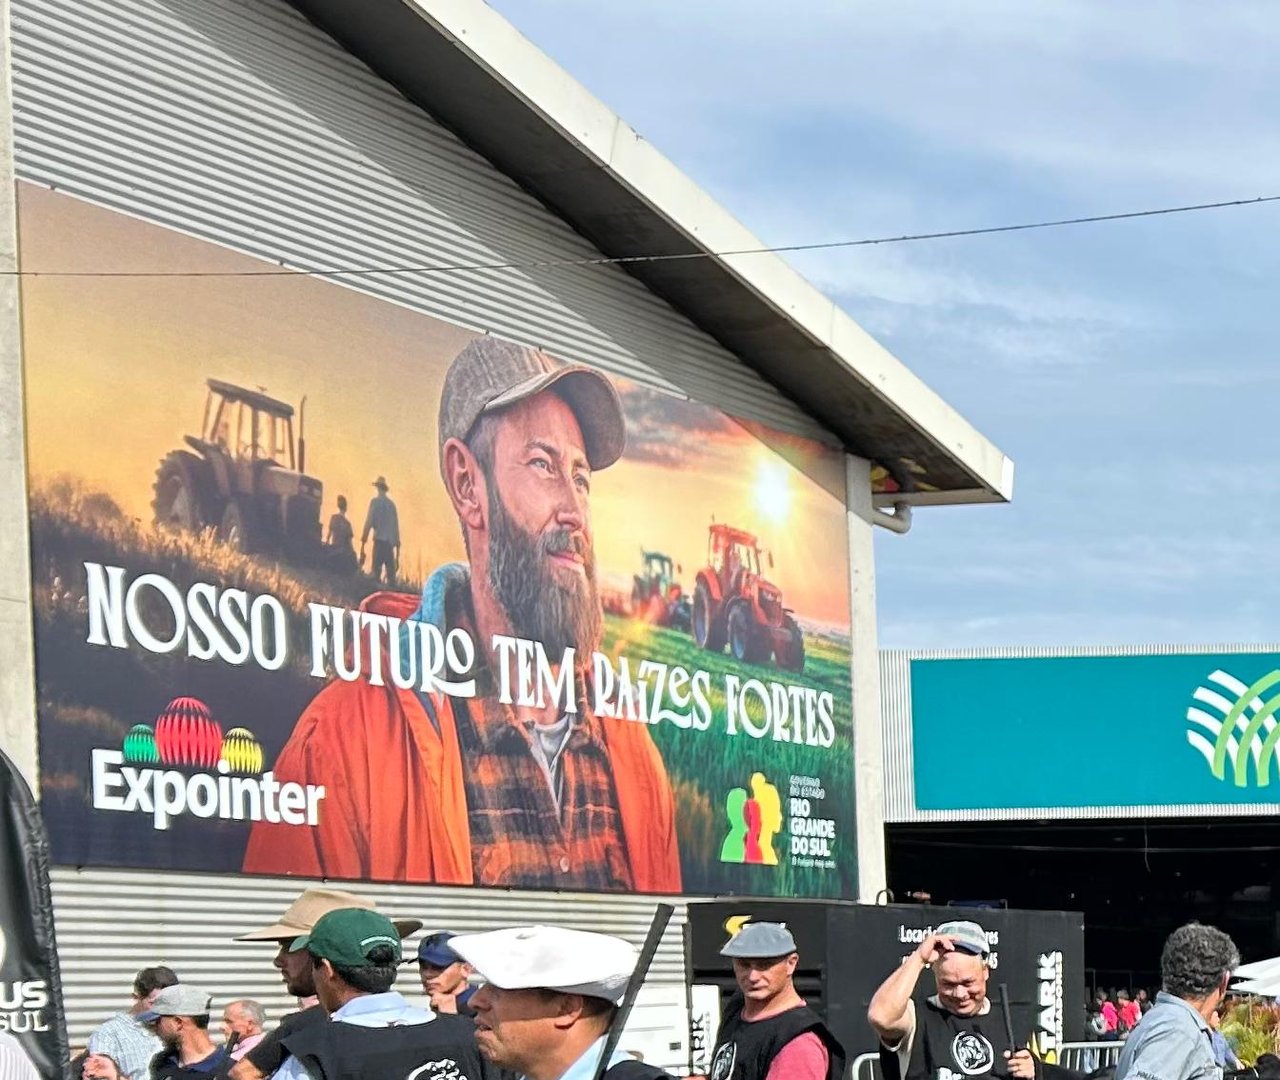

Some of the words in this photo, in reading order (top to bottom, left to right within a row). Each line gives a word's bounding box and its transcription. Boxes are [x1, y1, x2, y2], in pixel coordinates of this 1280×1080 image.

[83, 562, 288, 671] NOSSO
[308, 602, 476, 698] FUTURO
[492, 634, 577, 714] TEM
[725, 674, 836, 748] FORTES
[92, 748, 326, 830] Expointer
[790, 798, 811, 817] RIO
[791, 817, 836, 839] GRANDE
[791, 835, 808, 855] DO
[809, 837, 831, 857] SUL
